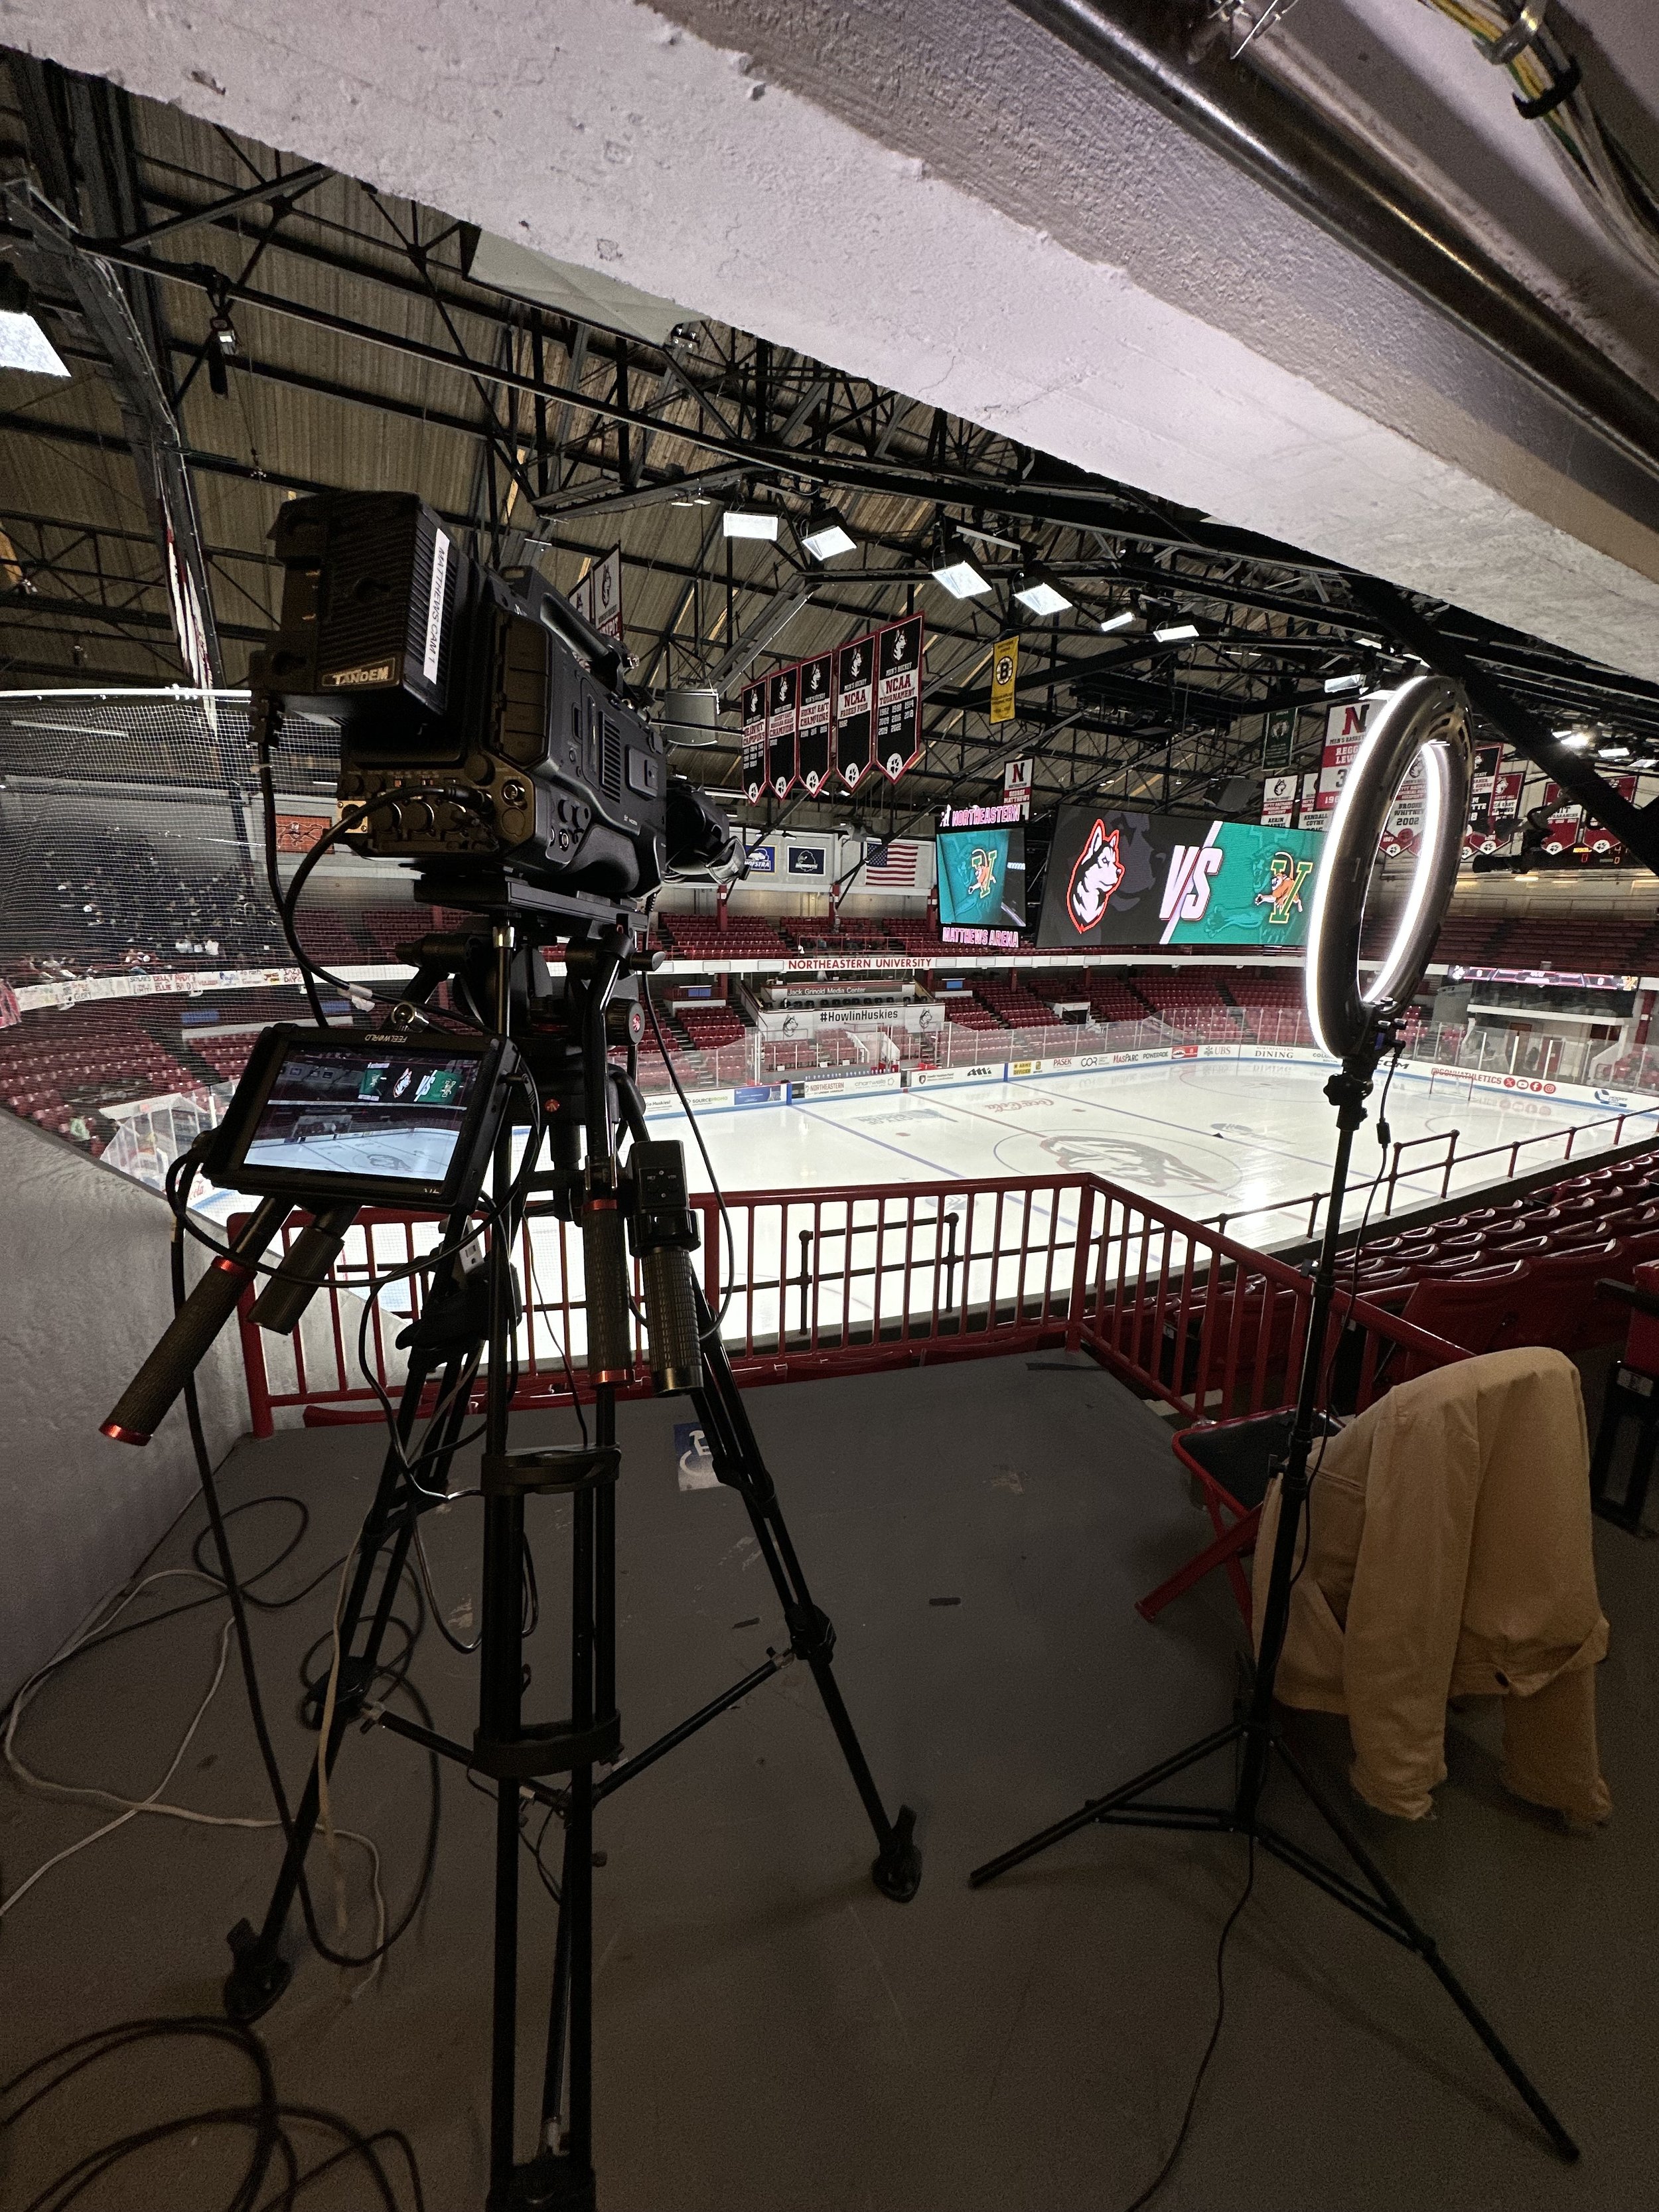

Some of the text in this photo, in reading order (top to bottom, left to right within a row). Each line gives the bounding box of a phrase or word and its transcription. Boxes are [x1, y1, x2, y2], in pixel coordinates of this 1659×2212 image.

[432, 547, 445, 620] MATTHEWS
[429, 624, 438, 651] CAM
[332, 666, 389, 685] TANDEM
[885, 674, 911, 694] NCAA
[844, 689, 866, 707] NCAA
[879, 687, 915, 705] TOURNAMENT
[800, 711, 829, 727] CHAMPIONS
[1012, 762, 1025, 783] N
[952, 803, 1021, 826] NORTHEASTERN
[1396, 817, 1419, 826] 2002
[745, 860, 770, 869] HOFSTRA
[1159, 844, 1223, 921] VS
[942, 927, 1019, 948] MATTHEWS ARENA
[788, 958, 932, 970] NORTHEASTERN UNIVERSITY
[820, 1009, 898, 1022] #HowlinHuskies
[365, 1033, 408, 1043] FEELWORLD
[1214, 1046, 1231, 1055] UBS
[1254, 1051, 1294, 1059] DINING
[1053, 1058, 1072, 1067] PASEK
[810, 1082, 845, 1092] NORTHEASTERN
[985, 1098, 1054, 1112] Coca-Cola
